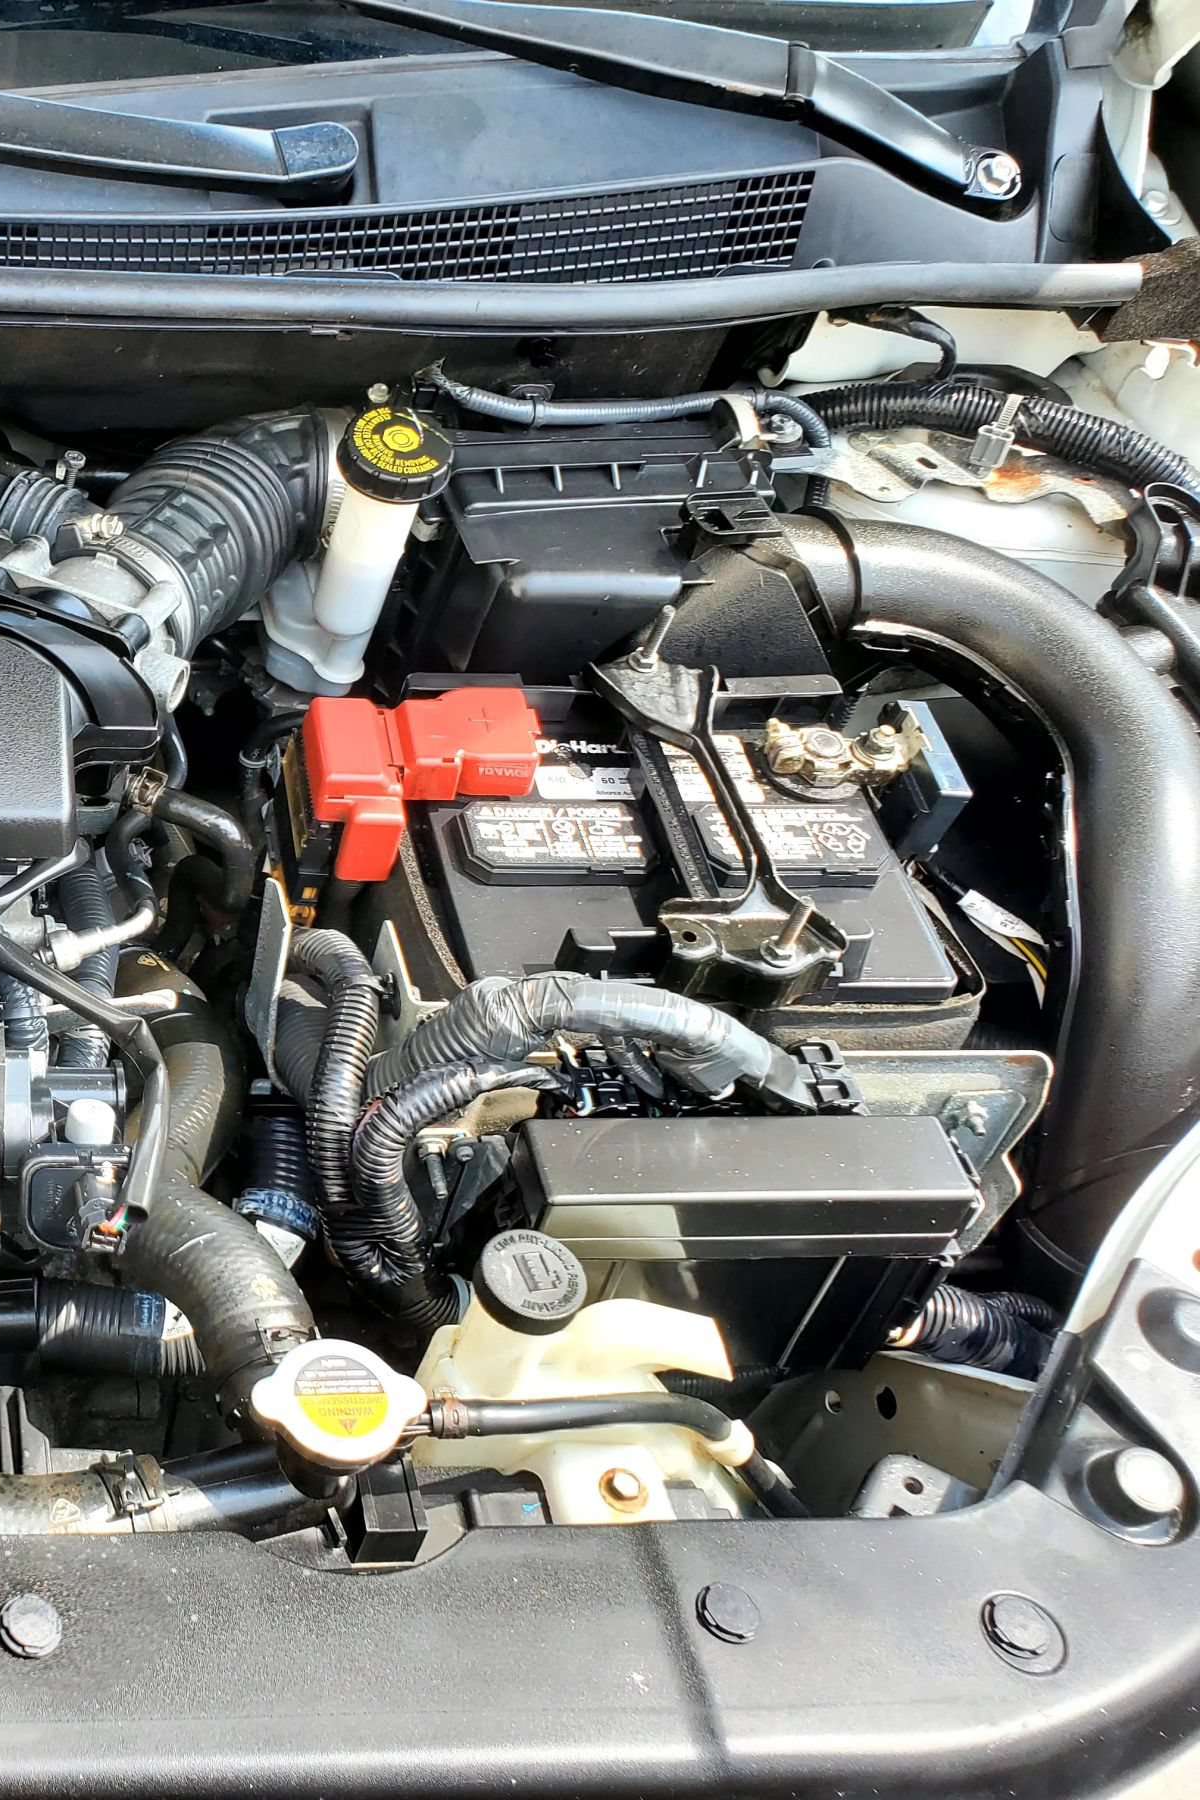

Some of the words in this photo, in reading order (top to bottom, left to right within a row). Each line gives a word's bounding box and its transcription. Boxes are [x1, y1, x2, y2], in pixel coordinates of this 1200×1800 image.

[368, 447, 393, 464] BEFORE
[395, 454, 431, 466] REMOVING
[375, 459, 402, 473] SEALED
[494, 807, 552, 818] DANGER
[566, 807, 623, 818] POISON
[318, 1407, 375, 1417] WARNING
